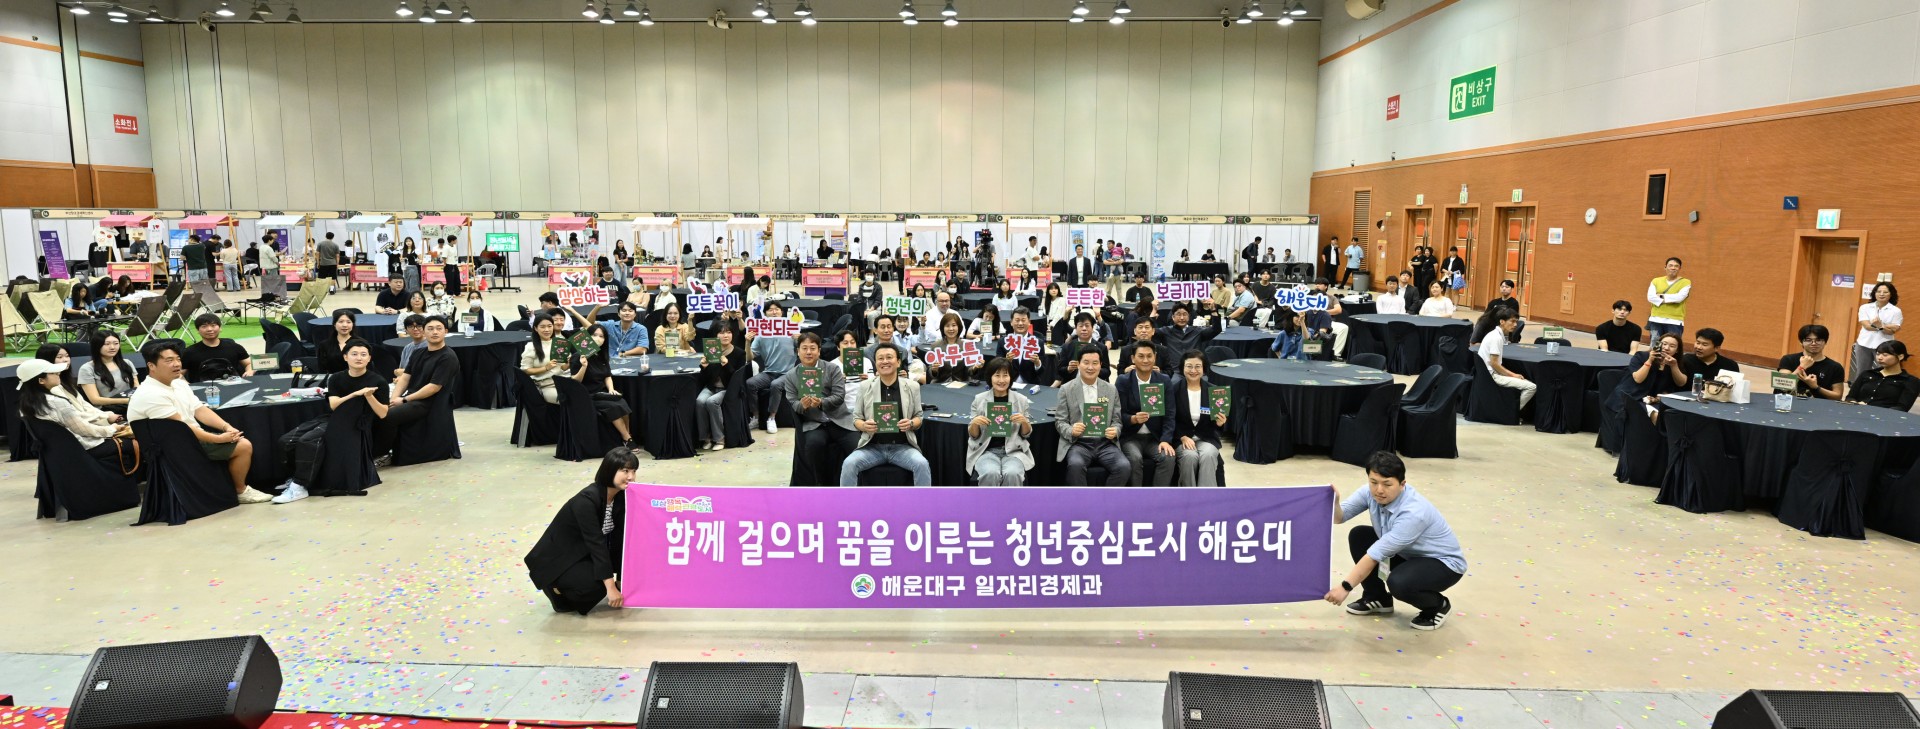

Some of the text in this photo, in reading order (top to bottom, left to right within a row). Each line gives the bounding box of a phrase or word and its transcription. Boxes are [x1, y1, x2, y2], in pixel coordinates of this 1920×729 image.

[1468, 77, 1492, 95] 비상구
[1472, 95, 1486, 107] EXIT
[559, 286, 608, 305] 상상하는
[1067, 289, 1105, 306] 든든한
[1157, 282, 1209, 299] 보금자리
[1277, 290, 1327, 309] 해운대
[688, 294, 738, 311] 모든 꿈이
[886, 297, 925, 315] 청년의
[747, 319, 799, 337] 실현되는
[1006, 335, 1040, 358] 청춘
[666, 517, 1293, 566] 함께 걸으며 꿈을 이루는 청년중심도시 해운대
[882, 574, 1103, 597] 해운대구 일자리경제과
